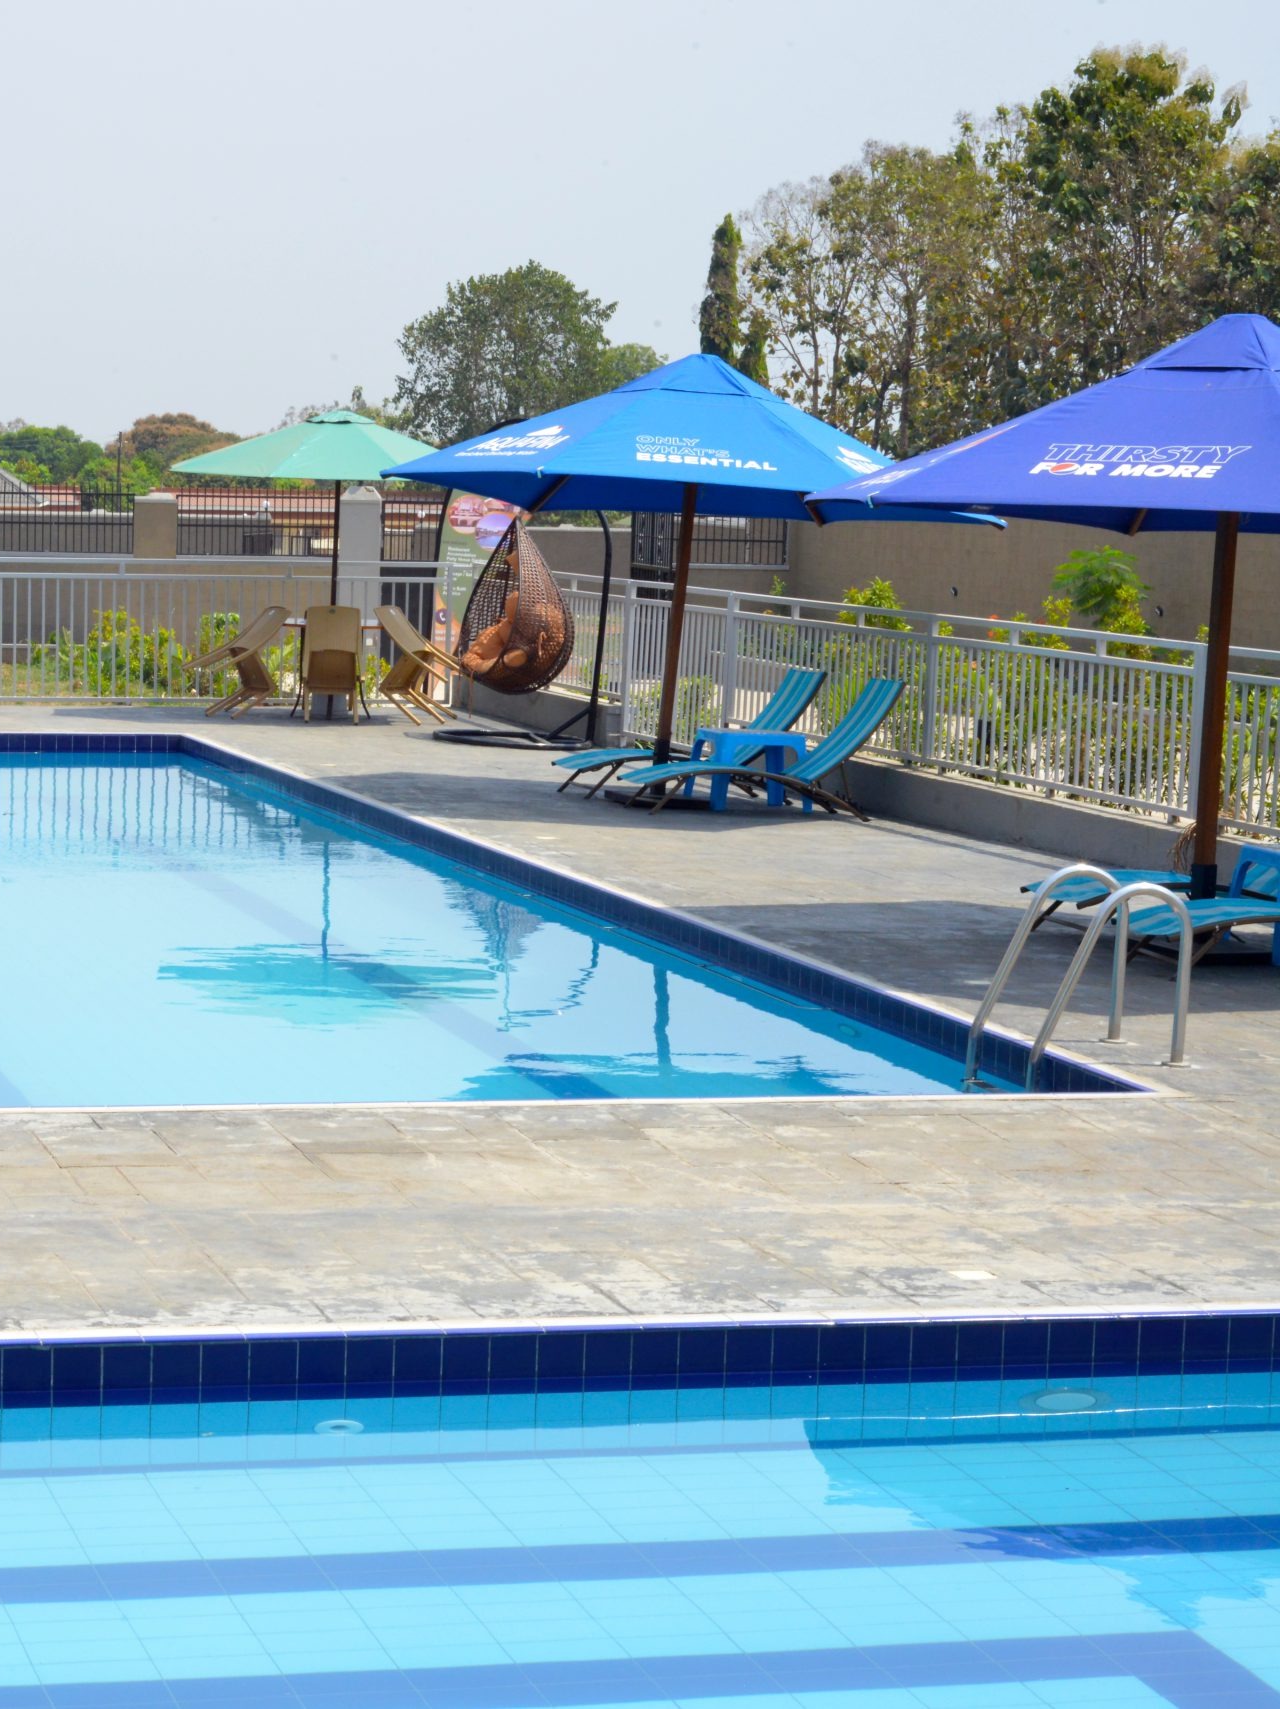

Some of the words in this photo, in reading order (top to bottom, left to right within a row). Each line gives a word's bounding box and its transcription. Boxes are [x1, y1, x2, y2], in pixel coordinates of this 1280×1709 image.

[636, 435, 700, 446] ONLY
[636, 444, 730, 458] WHAT'S
[1044, 443, 1253, 463] THIRSTY
[636, 452, 778, 471] ESSENTIAL
[1108, 464, 1223, 478] MORE
